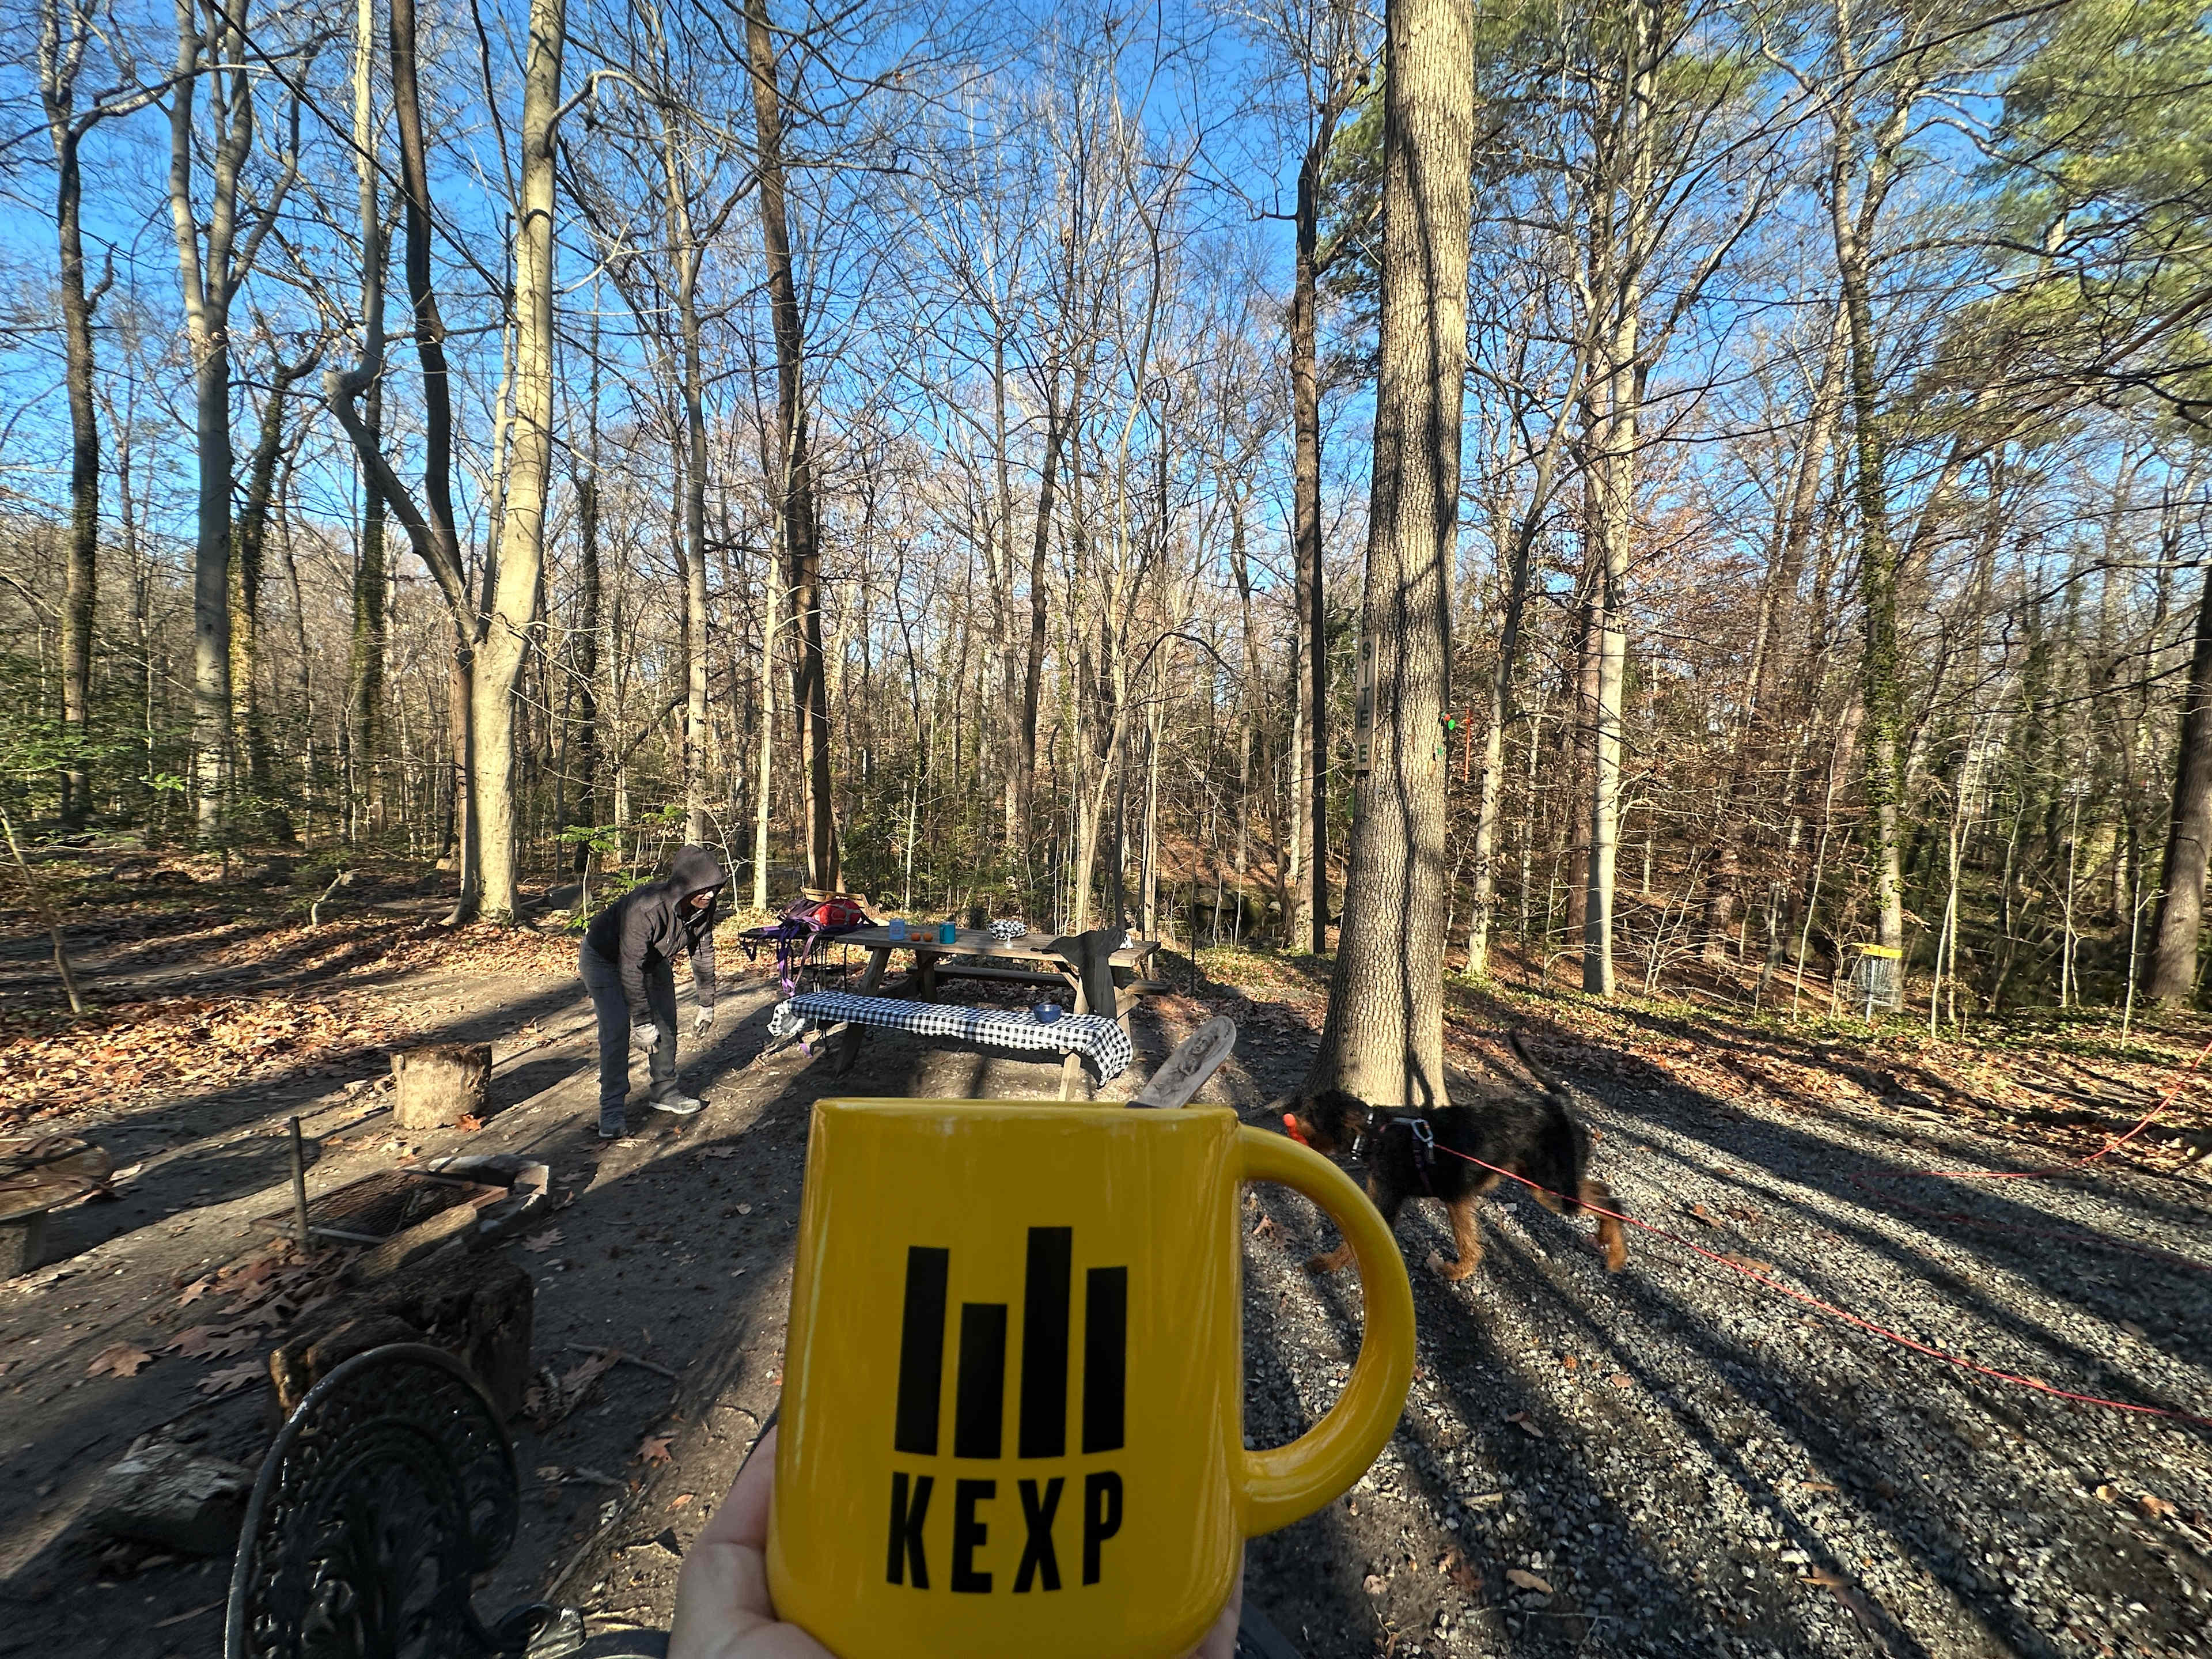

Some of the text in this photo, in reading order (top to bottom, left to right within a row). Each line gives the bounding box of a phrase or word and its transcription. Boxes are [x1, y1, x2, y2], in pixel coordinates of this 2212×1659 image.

[1358, 641, 1371, 763] SITE E
[886, 1470, 1123, 1594] KEXP
